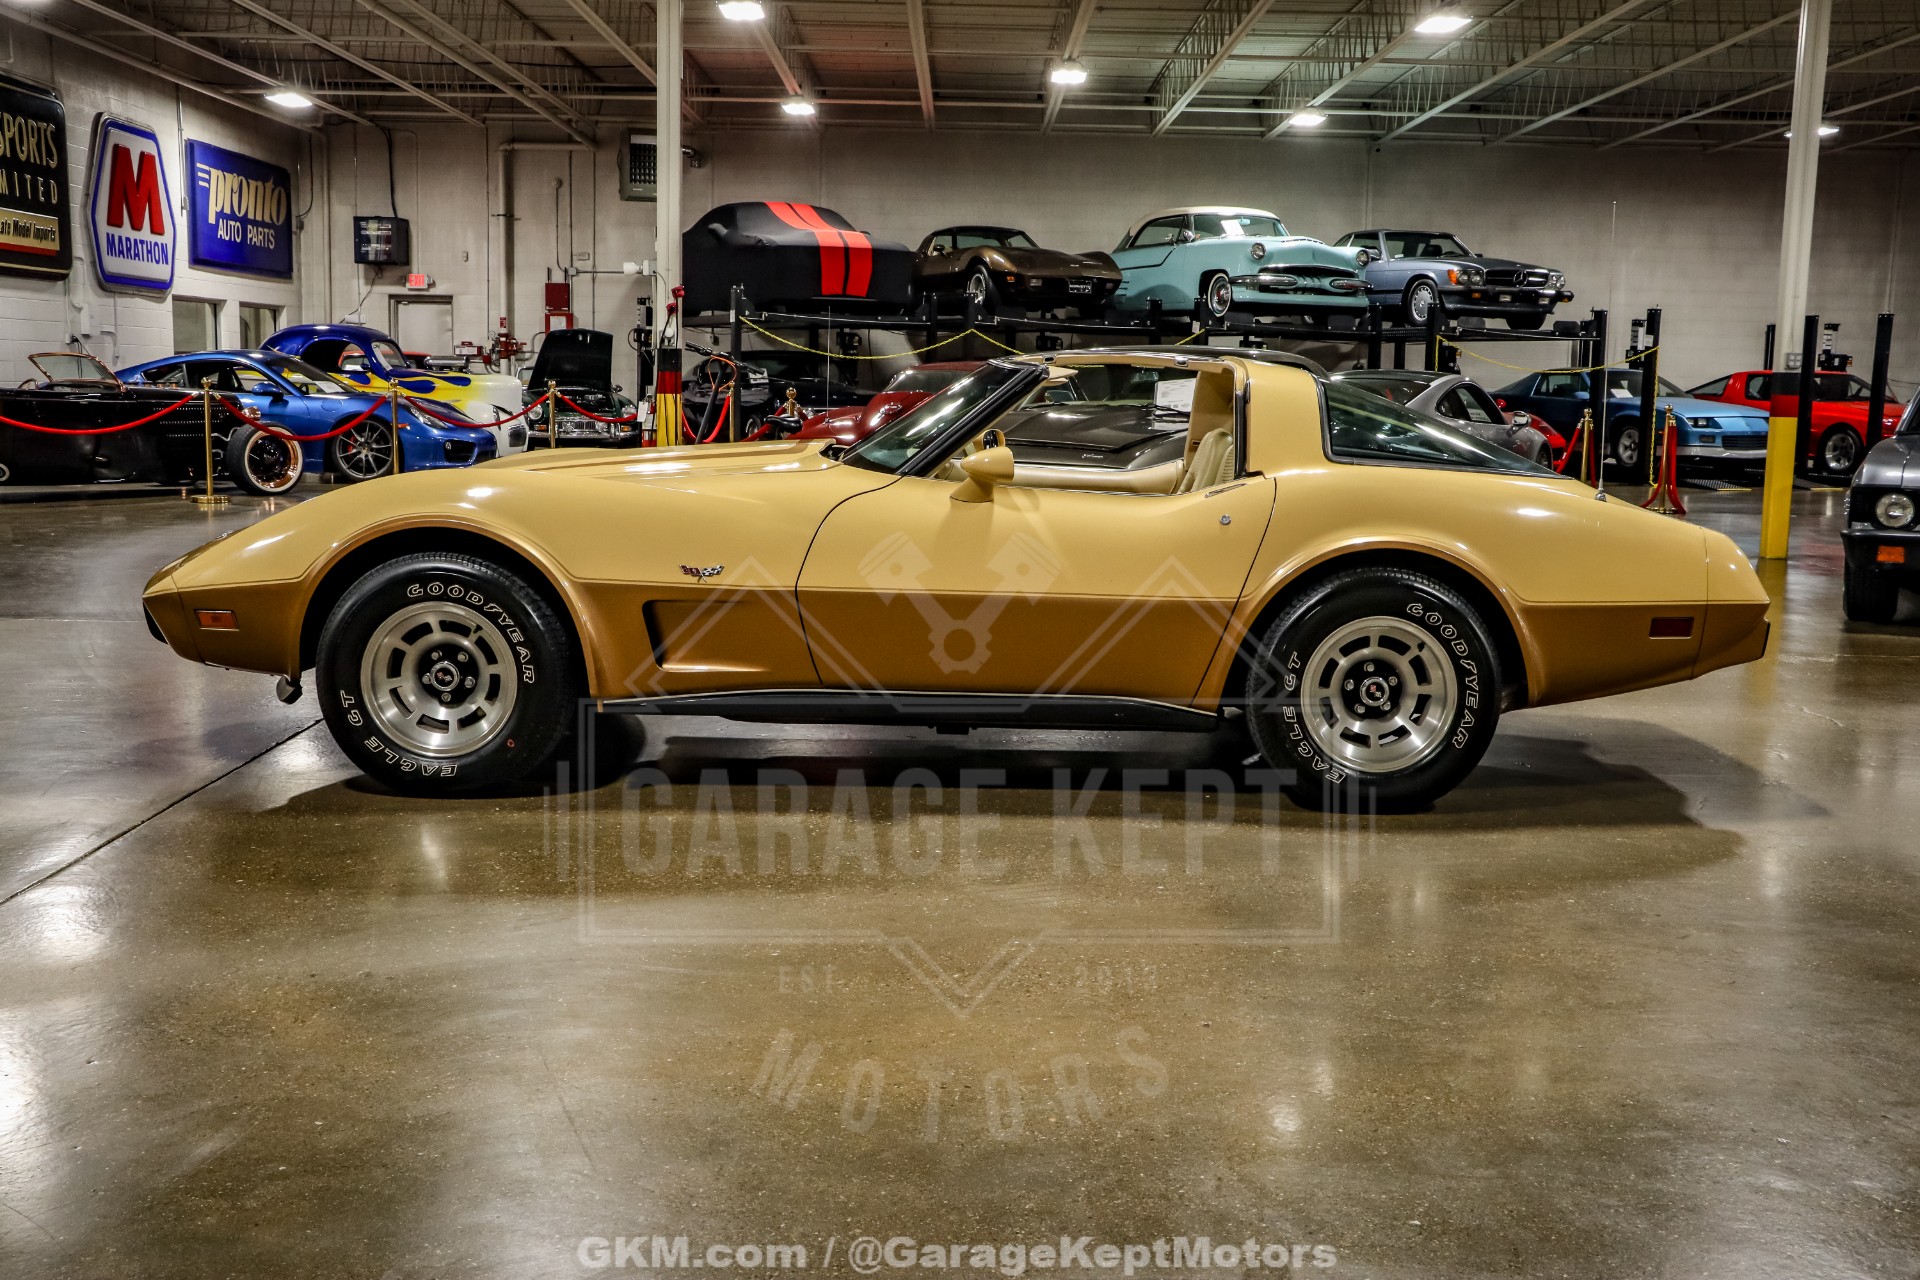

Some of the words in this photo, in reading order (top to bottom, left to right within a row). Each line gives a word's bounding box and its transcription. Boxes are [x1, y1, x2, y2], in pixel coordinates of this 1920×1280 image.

[207, 166, 287, 225] pronto
[12, 217, 32, 238] Model
[217, 220, 242, 243] AUTO
[247, 227, 275, 249] PARTS
[106, 232, 169, 266] MARATHON
[408, 274, 426, 287] EXIT
[407, 582, 535, 684] GOODYEAR
[1284, 651, 1302, 691] GT
[1406, 602, 1479, 750] GOODYEAR
[340, 689, 363, 727] GT
[364, 735, 458, 777] EAGLE
[1283, 706, 1346, 784] EAGLE
